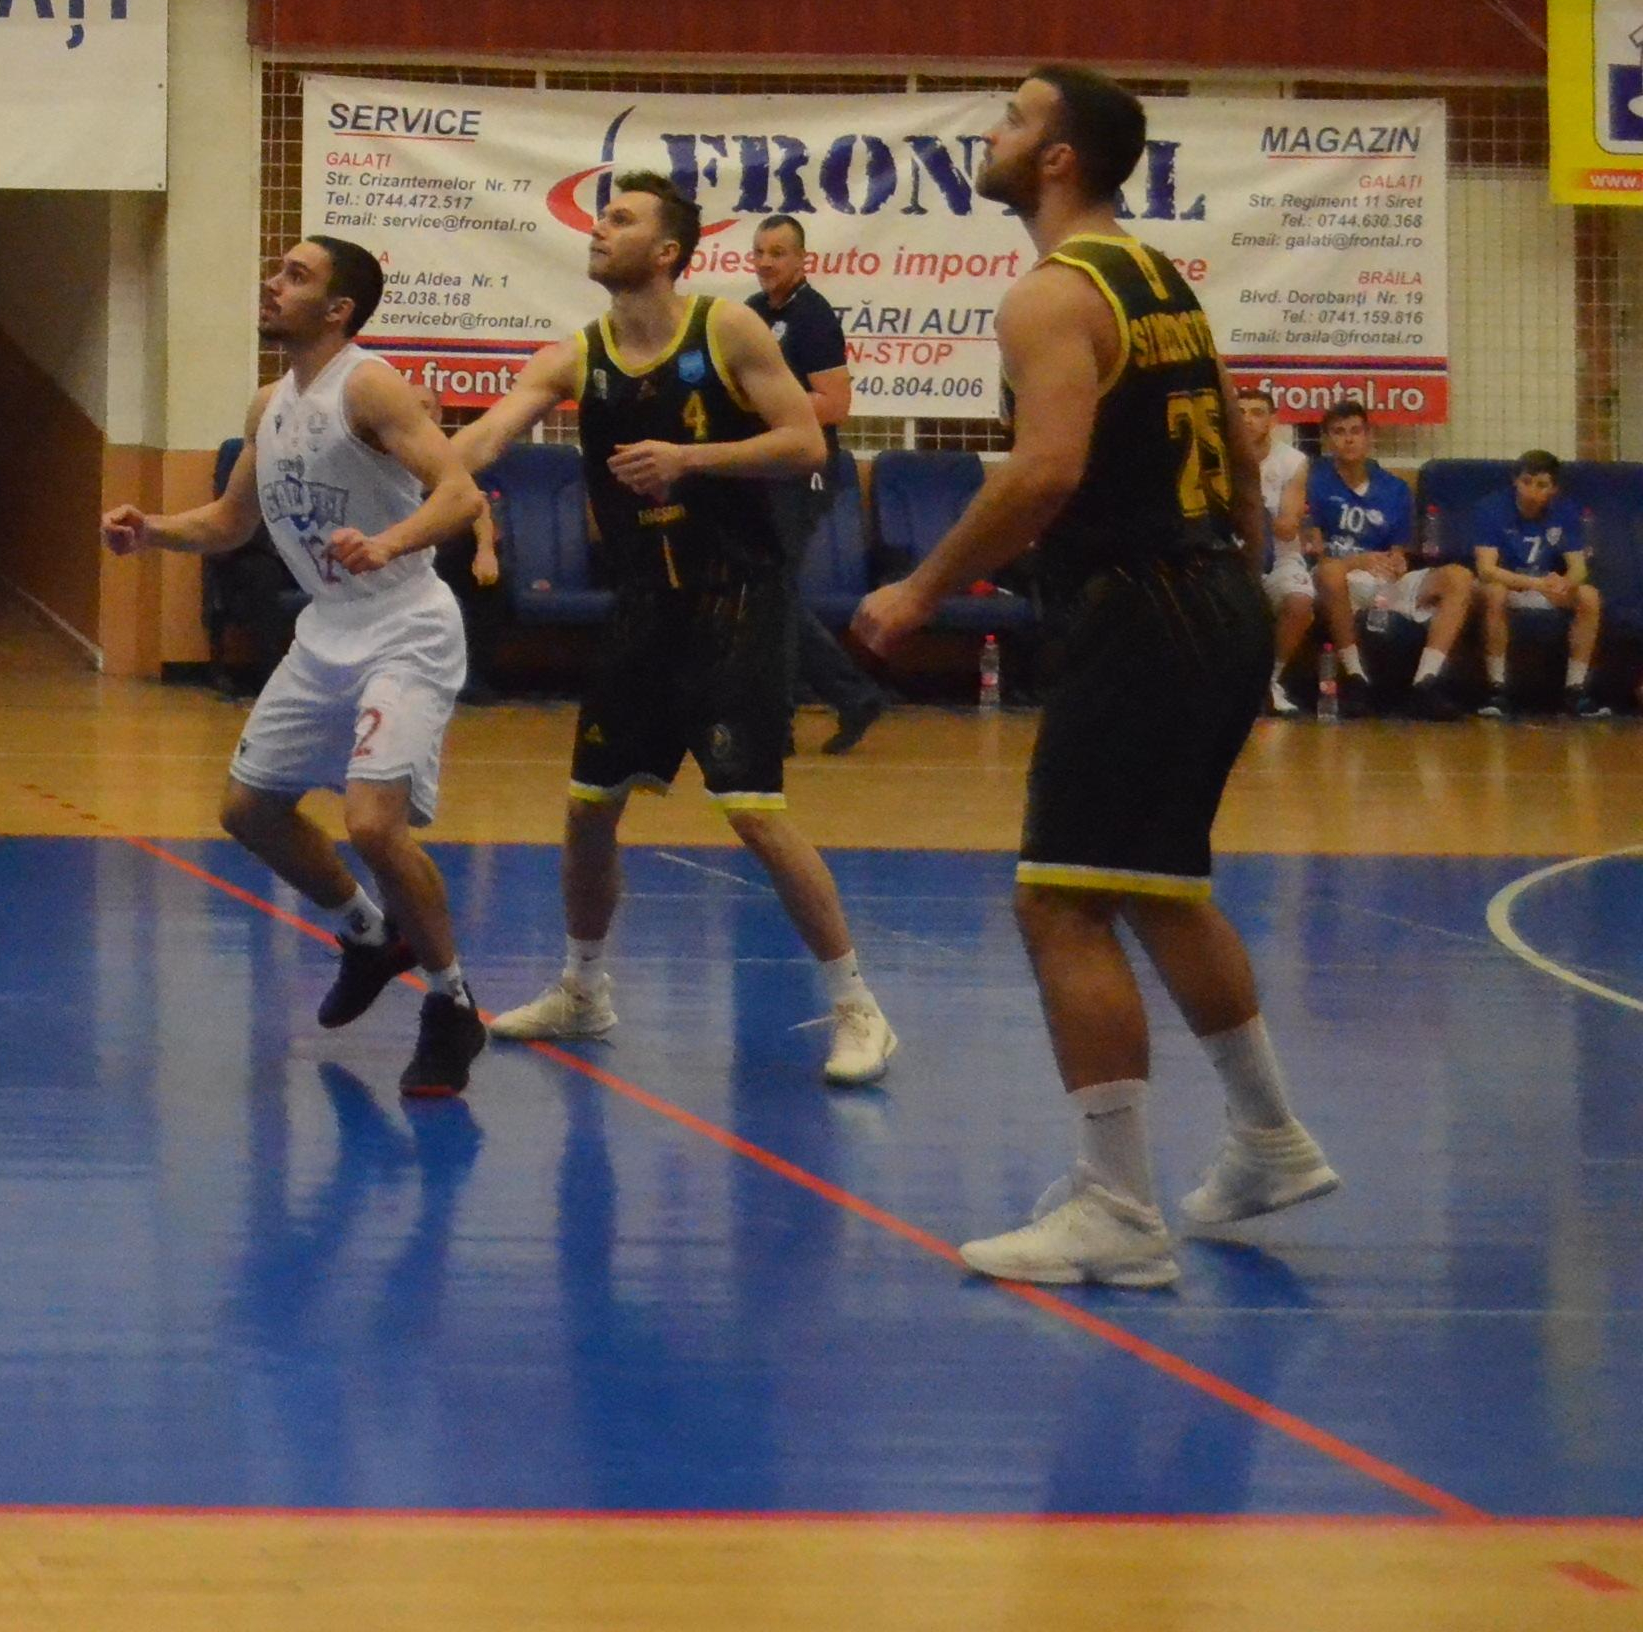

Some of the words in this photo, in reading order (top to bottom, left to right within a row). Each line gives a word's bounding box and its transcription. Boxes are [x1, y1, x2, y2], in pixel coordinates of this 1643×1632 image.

[327, 103, 482, 136] SERVICE
[1260, 126, 1421, 154] MAGAZIN
[325, 152, 392, 170] GALAȚI
[325, 171, 353, 186] Str.
[359, 172, 476, 191] Crizantemelor
[484, 174, 507, 192] Nr.
[512, 179, 532, 192] 77
[365, 194, 474, 210] 0744.472.517
[1248, 194, 1275, 208] Str.
[1280, 194, 1358, 212] Regiment
[1364, 194, 1380, 207] 11
[1385, 194, 1423, 209] Siret
[324, 212, 377, 226] Email:
[382, 214, 538, 233] service@frontal.ro
[1231, 233, 1281, 247] Email:
[803, 247, 881, 276] auto
[895, 246, 1020, 284] import
[415, 273, 462, 288] Aldea
[471, 273, 494, 289] Nr.
[500, 275, 509, 288] 1
[383, 291, 472, 307] 52.038.168
[1239, 289, 1281, 304] Blvd.
[1376, 291, 1398, 305] Nr.
[1405, 291, 1423, 305] 19
[380, 312, 552, 330] servicebr@frontal.ro
[1230, 328, 1281, 344] Email:
[1285, 329, 1424, 347] braila@frontal.ro
[681, 388, 708, 441] 4
[1338, 502, 1365, 533] 10
[1523, 536, 1542, 565] 7
